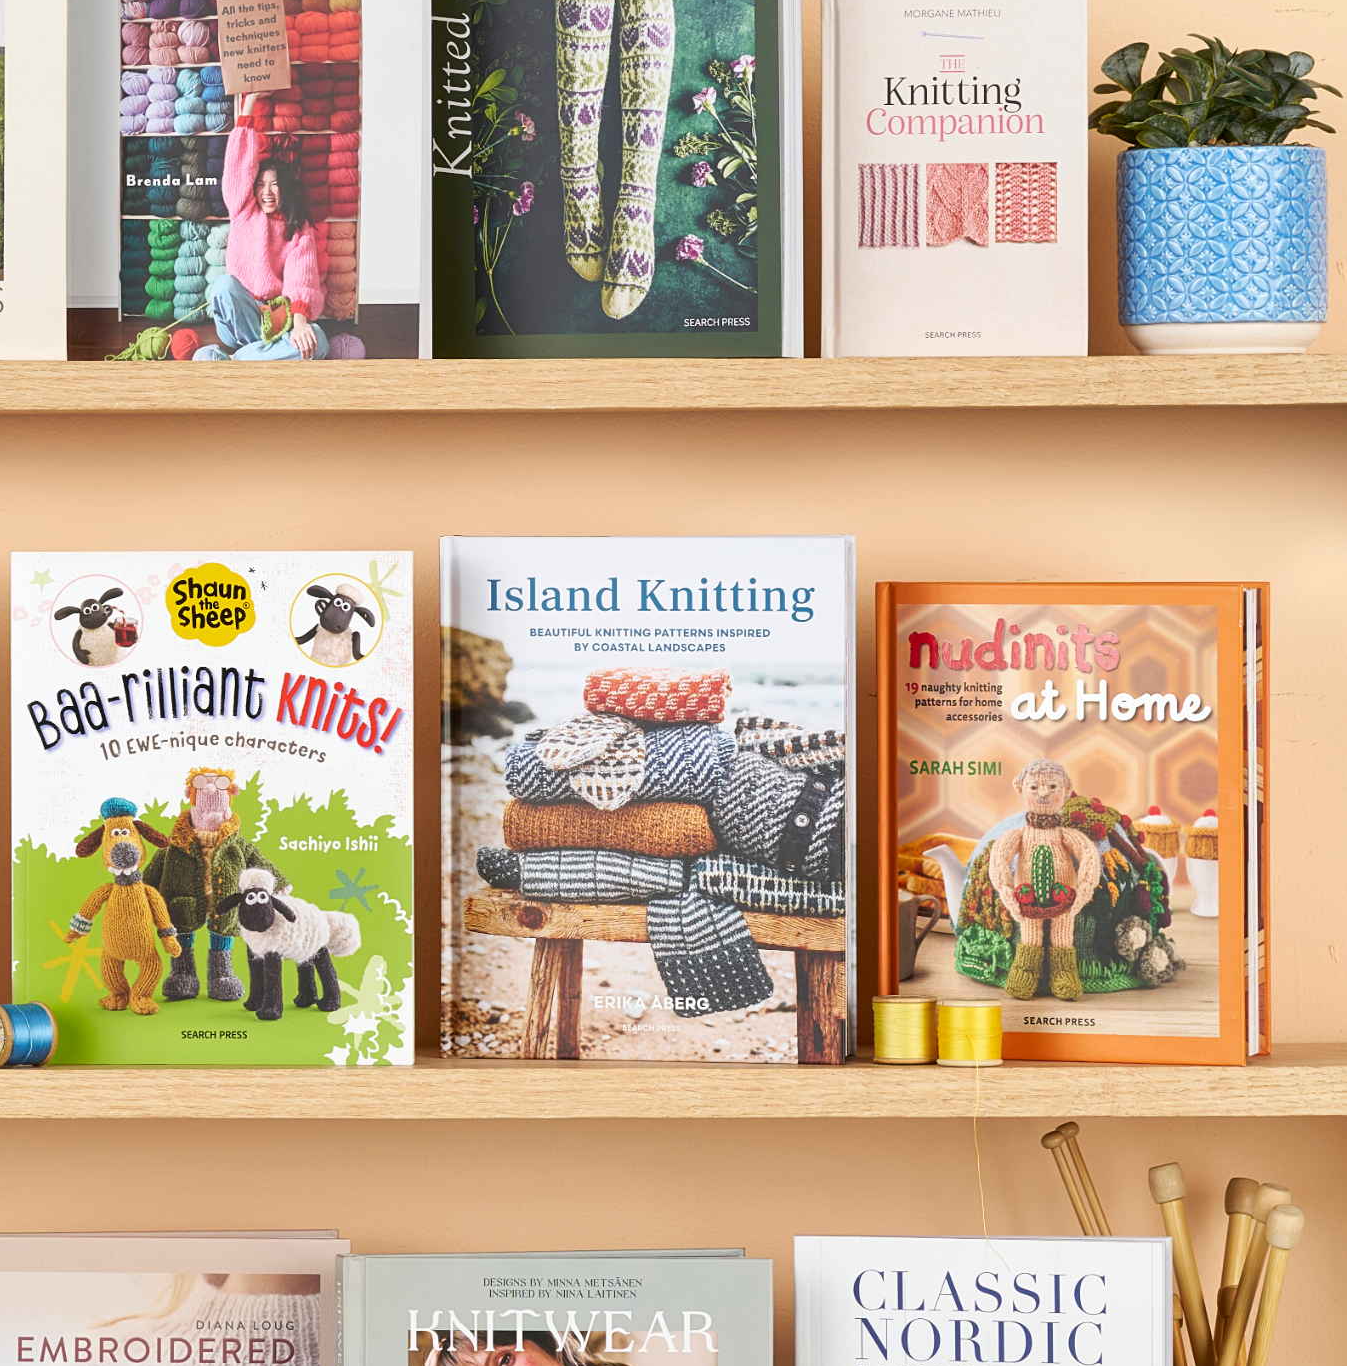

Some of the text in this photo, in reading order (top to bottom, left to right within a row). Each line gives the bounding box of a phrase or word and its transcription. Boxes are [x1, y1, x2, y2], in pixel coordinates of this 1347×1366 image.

[905, 9, 1001, 18] MORGANE MATHIEU
[226, 29, 280, 43] techniques
[884, 77, 1022, 113] Knitting
[866, 107, 1045, 142] Companion
[126, 174, 217, 187] Brenda Lam
[173, 581, 247, 602] Shaun
[486, 577, 815, 622] Island Knitting
[178, 605, 245, 631] Sheep
[530, 628, 770, 638] BEAUTIFUL KNITTING PATTERNS INSPIRED
[905, 681, 1003, 695] 19 naughty knitting
[1011, 679, 1211, 722] at Home
[946, 711, 1003, 722] accessories
[909, 761, 1002, 775] SARAH SIMI
[279, 836, 378, 852] Sachiyo Ishii
[181, 1031, 248, 1040] SEARCH PRESS
[489, 1289, 637, 1299] INSPIRED BY NIINA LAITINEN
[853, 1270, 1107, 1315] CLASSIC
[196, 1320, 295, 1331] DIANA LOUG
[408, 1310, 719, 1353] KNITWEAR
[855, 1317, 1104, 1365] NORDIC
[17, 1337, 295, 1365] EMBROIDERED
